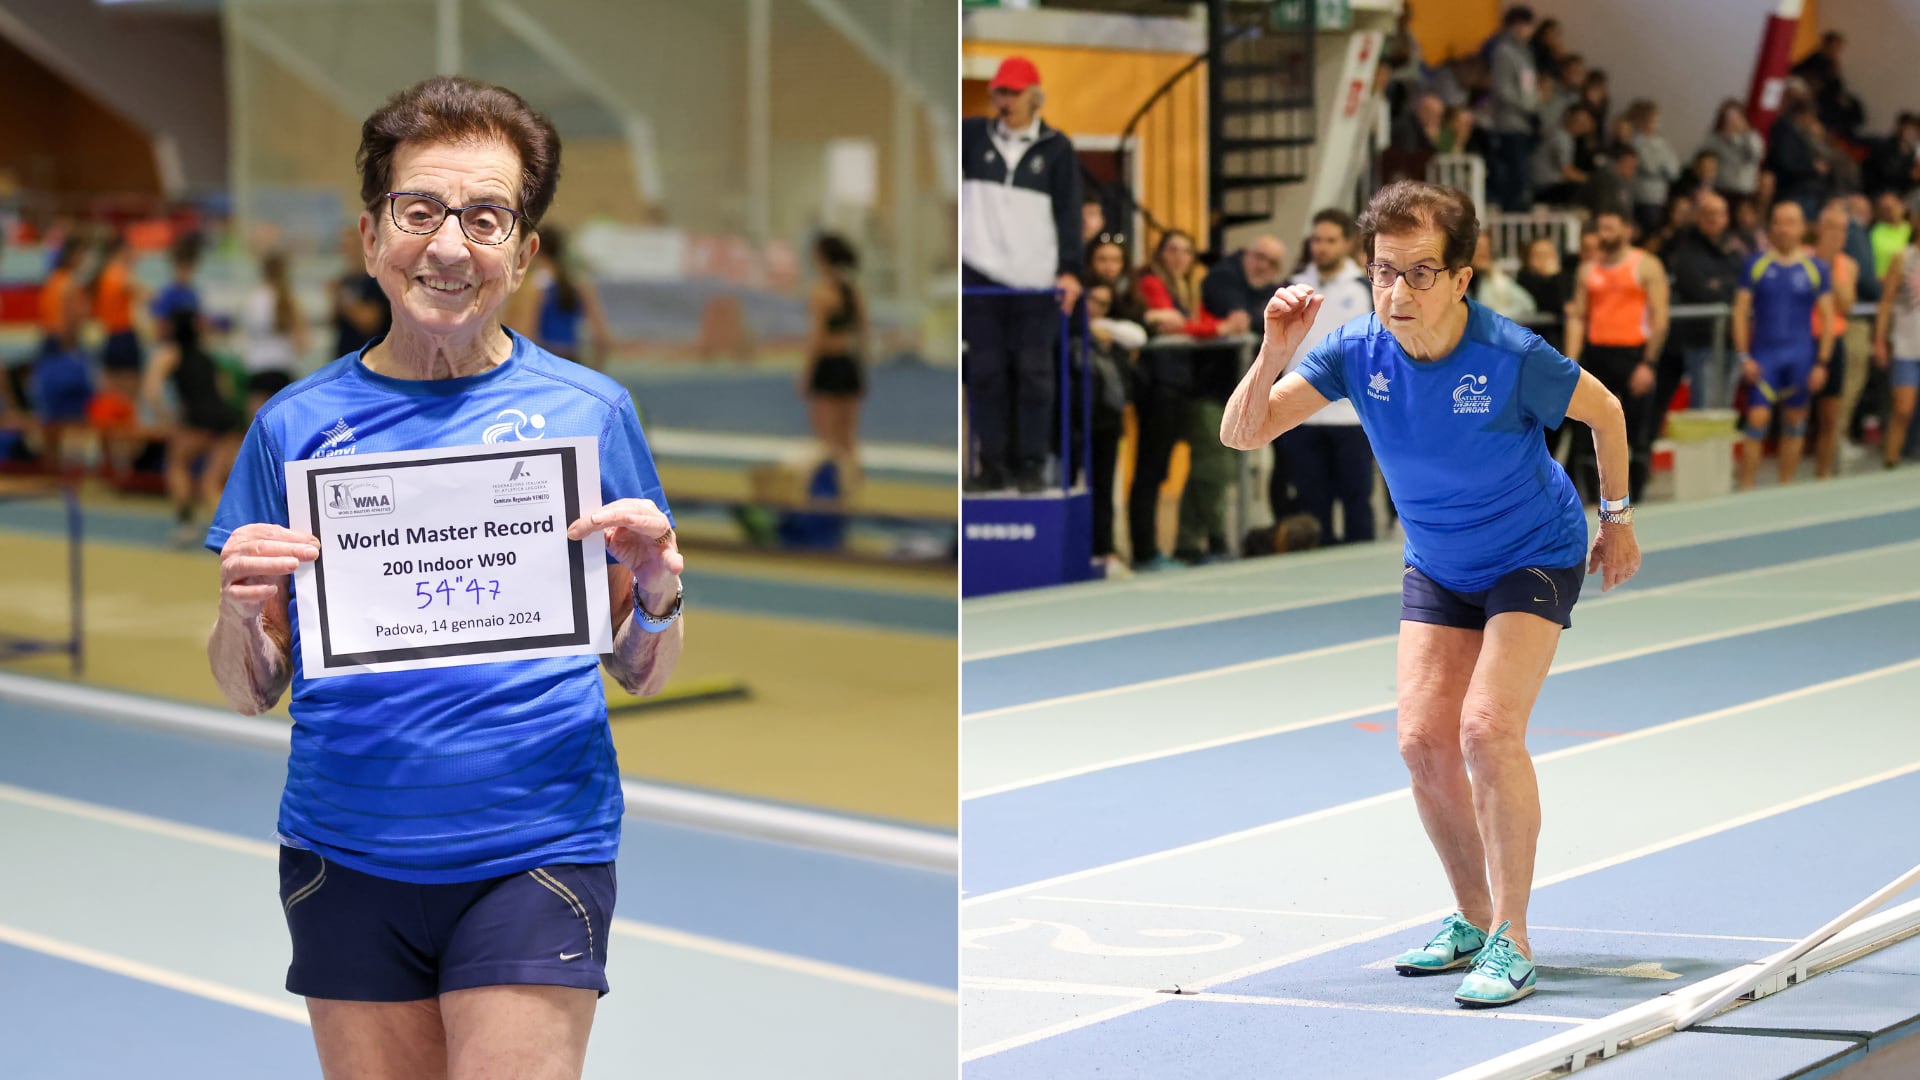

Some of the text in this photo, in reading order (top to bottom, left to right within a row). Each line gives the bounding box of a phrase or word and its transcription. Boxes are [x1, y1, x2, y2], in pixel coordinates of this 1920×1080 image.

[353, 495, 390, 508] WMA
[337, 515, 554, 550] World Master Record
[383, 551, 517, 576] 200 Indoor W90
[376, 611, 541, 637] Padova, 14 gennaio 2024
